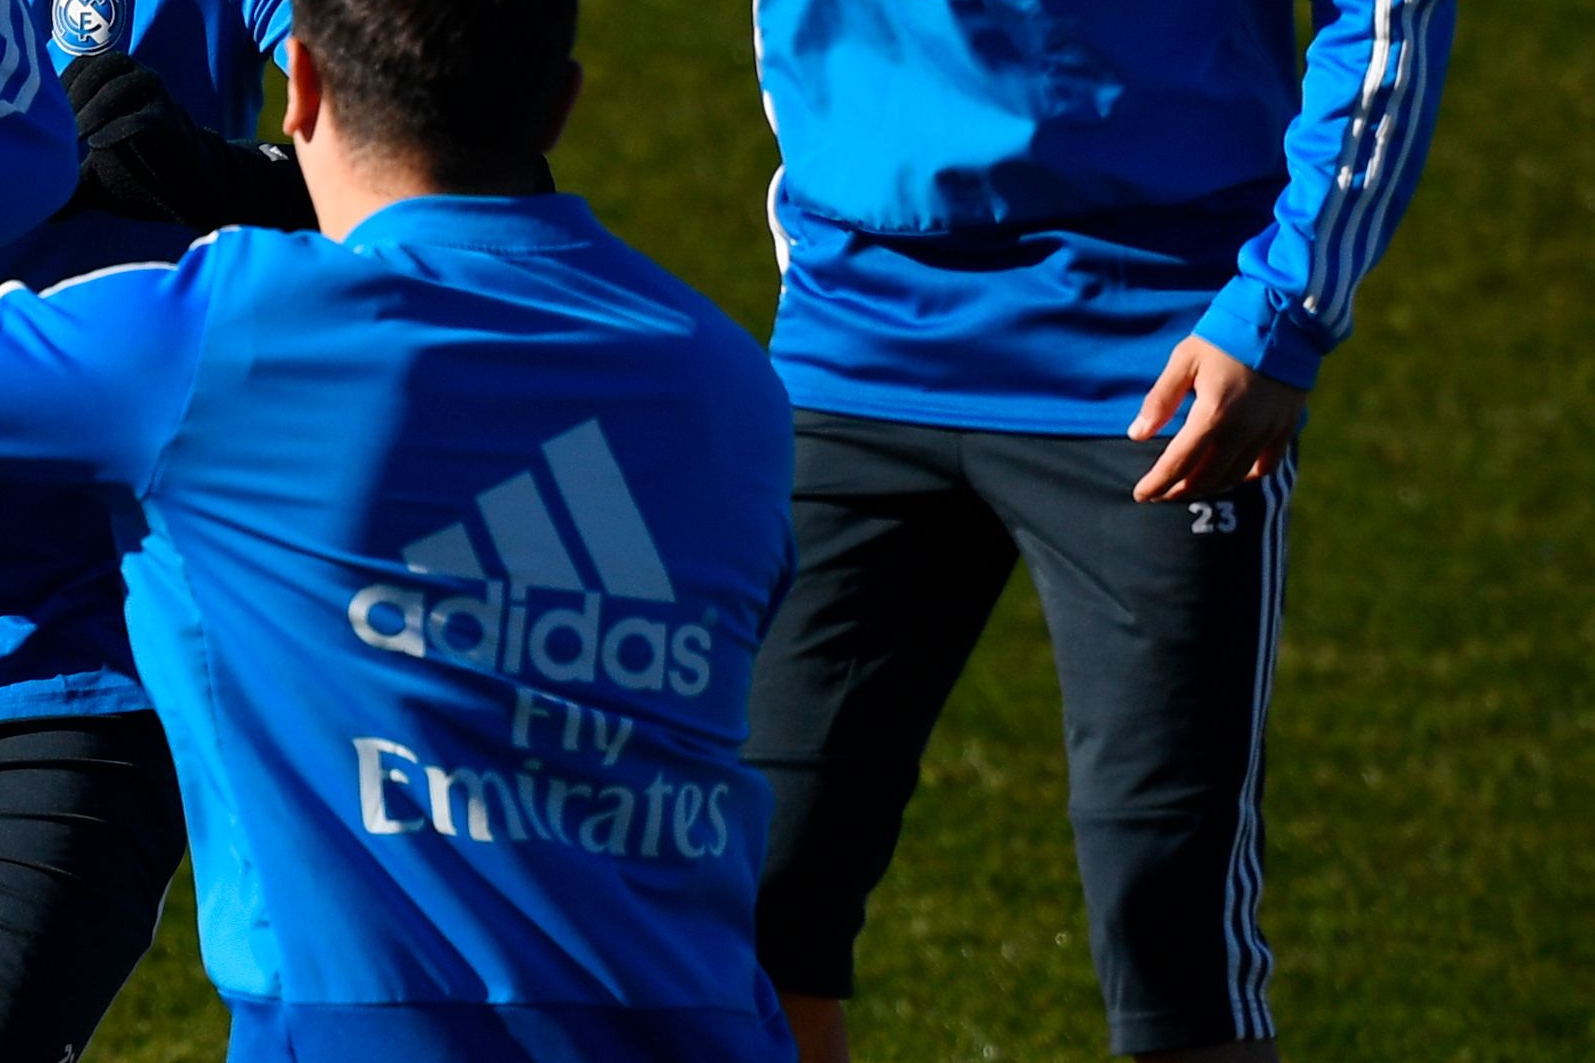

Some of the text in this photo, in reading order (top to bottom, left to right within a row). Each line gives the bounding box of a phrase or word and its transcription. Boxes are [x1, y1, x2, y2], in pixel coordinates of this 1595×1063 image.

[1188, 501, 1237, 534] 23
[348, 579, 712, 697] adidas
[512, 687, 637, 765] Fly
[352, 737, 729, 858] Emirates
